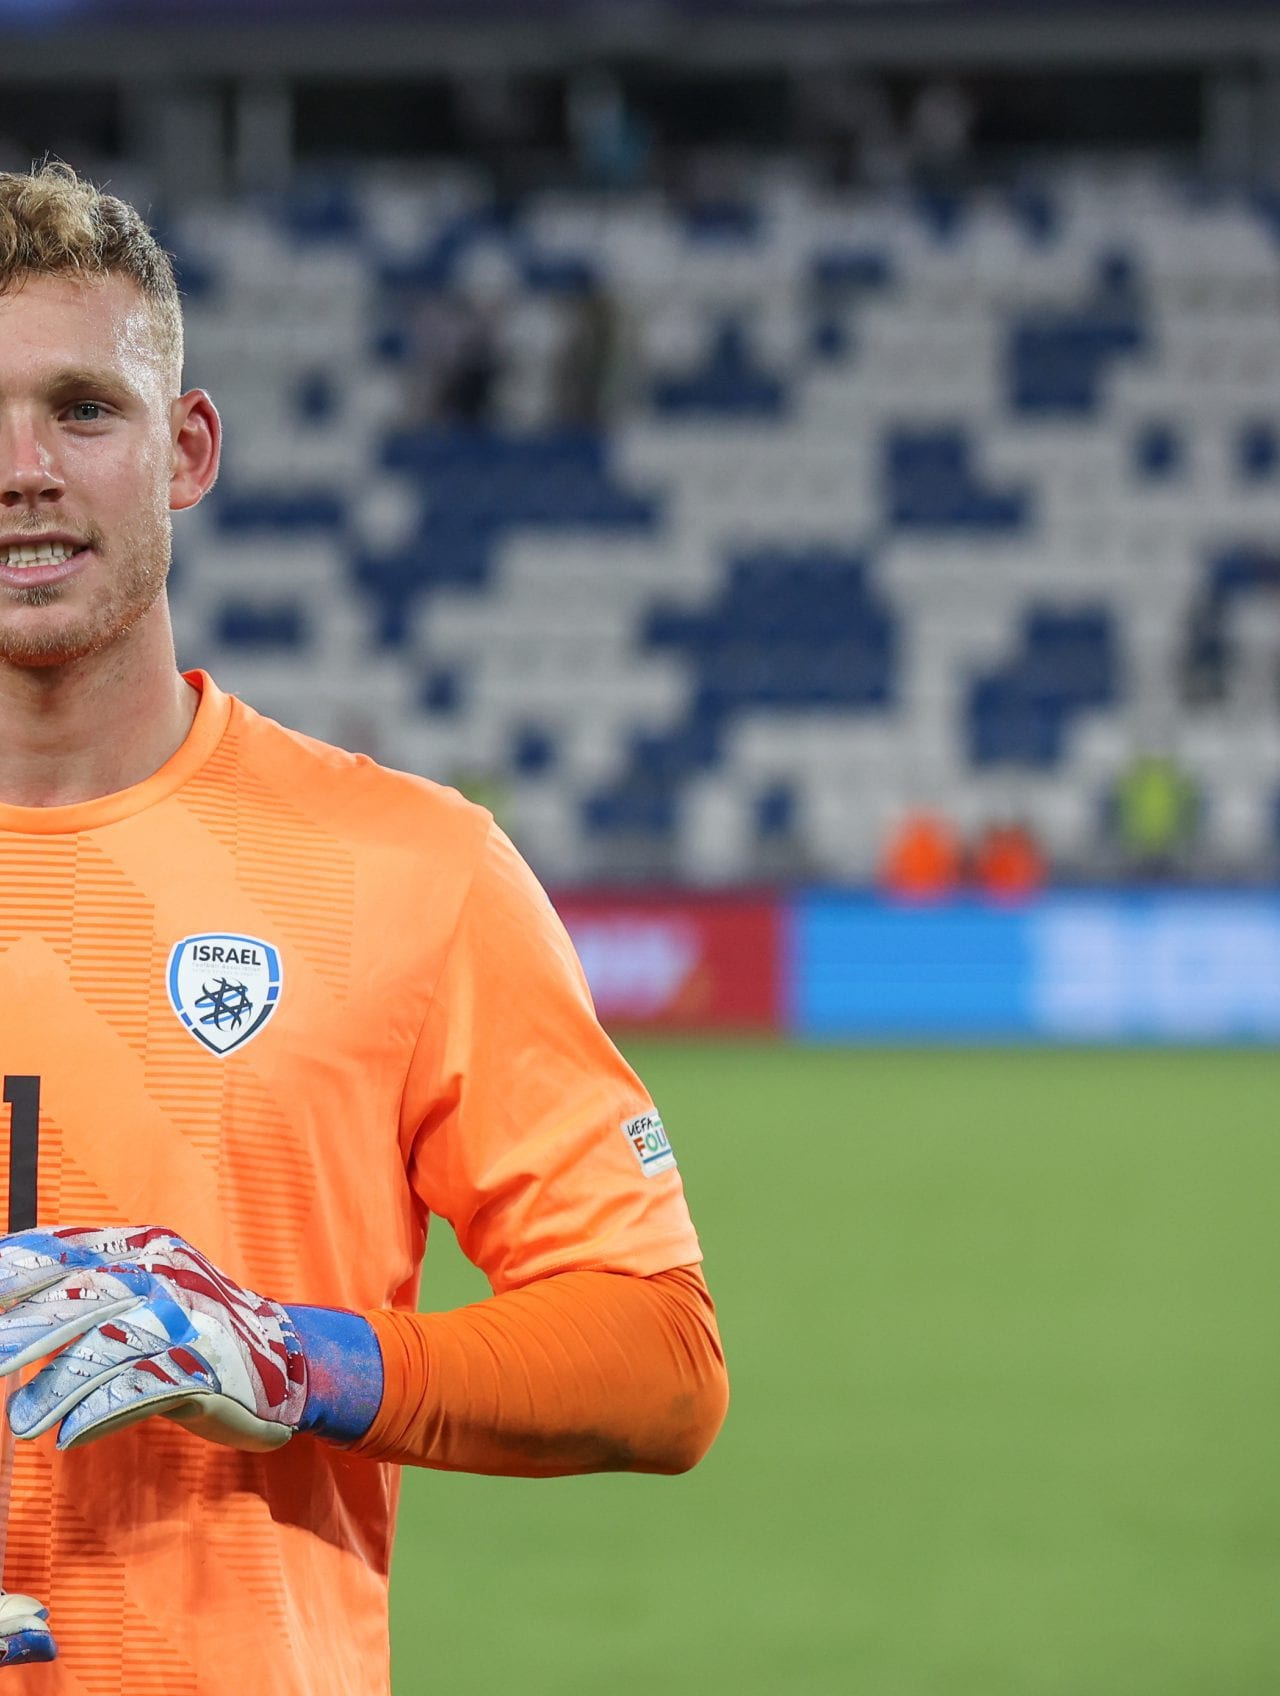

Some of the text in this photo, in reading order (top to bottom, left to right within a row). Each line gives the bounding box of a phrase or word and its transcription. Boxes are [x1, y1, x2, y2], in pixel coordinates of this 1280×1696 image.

[192, 945, 261, 966] ISRAEL
[627, 1116, 654, 1137] UEFA
[3, 1075, 41, 1234] 1
